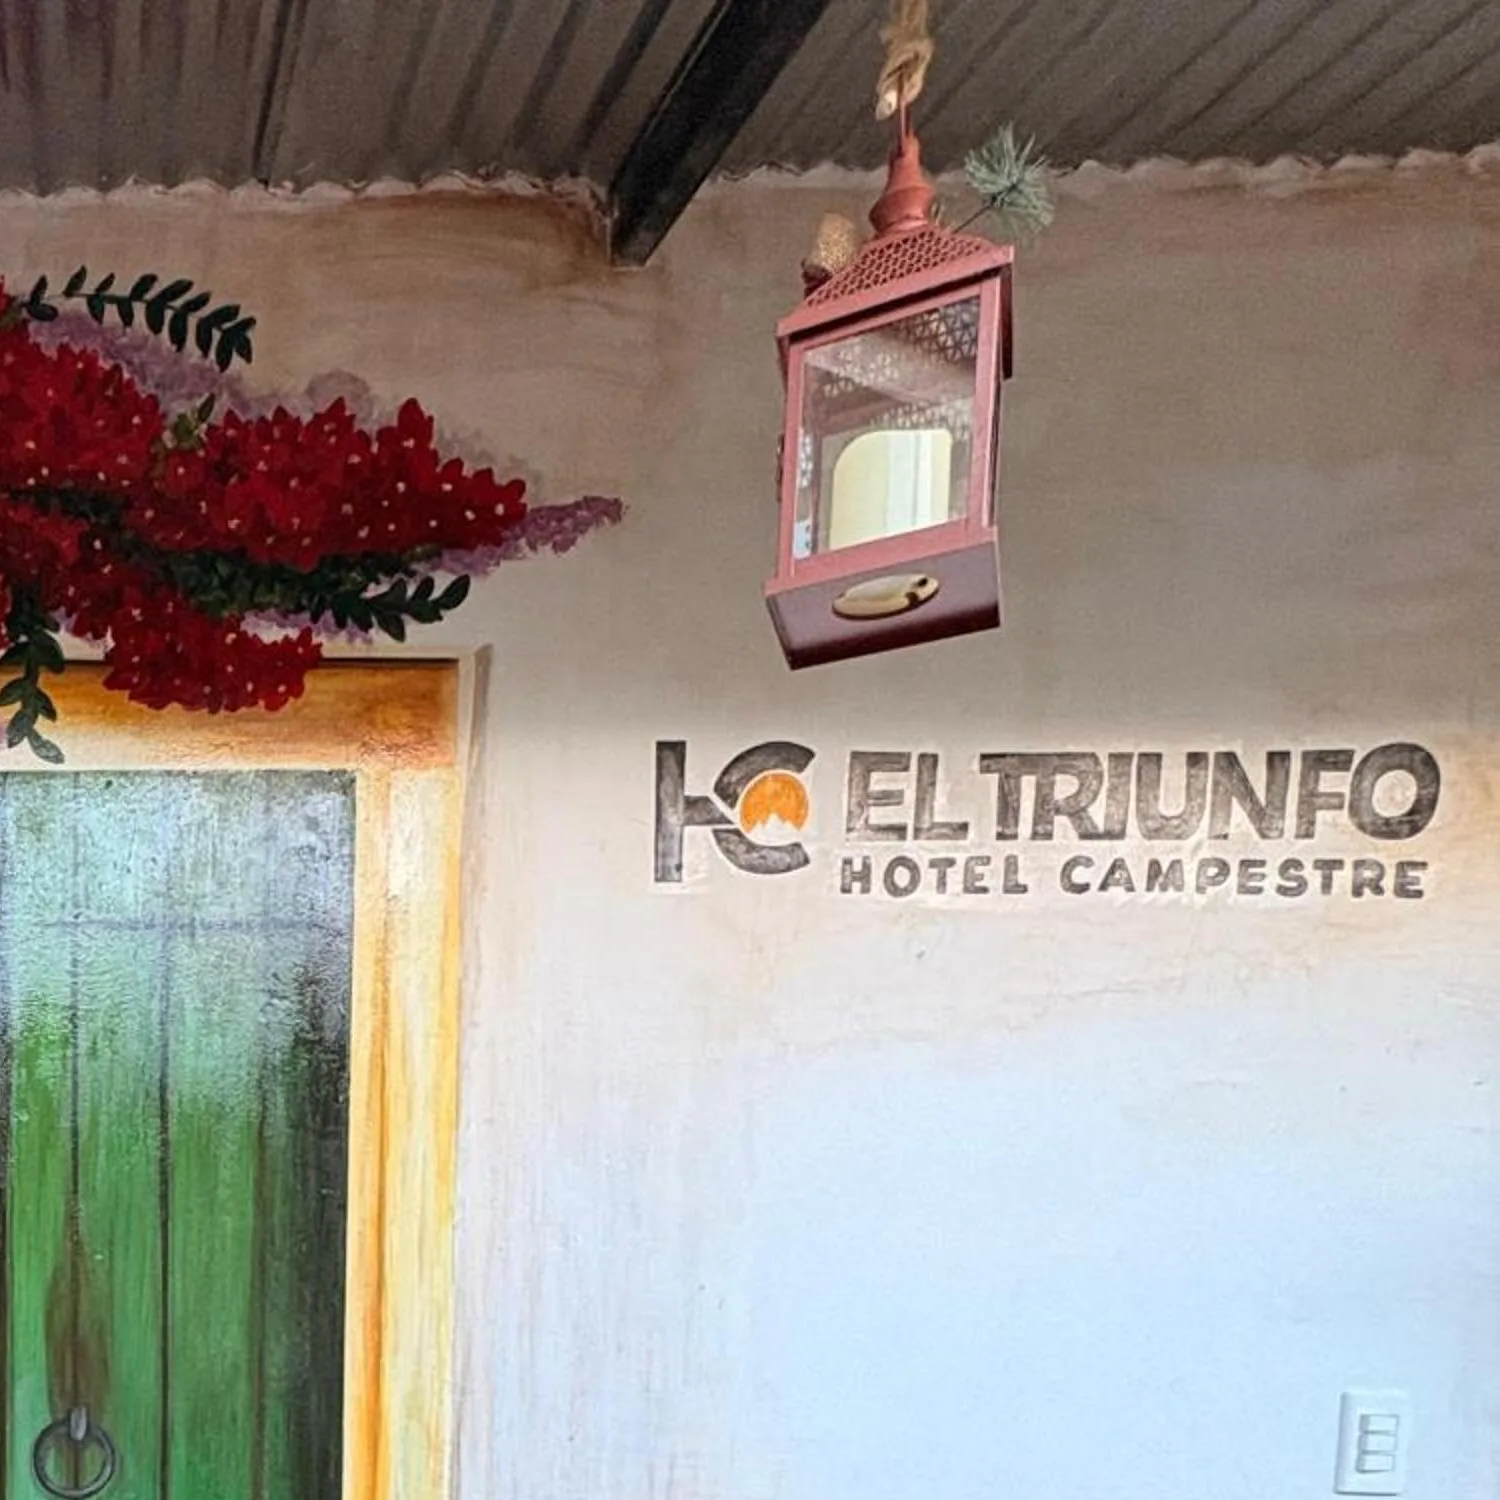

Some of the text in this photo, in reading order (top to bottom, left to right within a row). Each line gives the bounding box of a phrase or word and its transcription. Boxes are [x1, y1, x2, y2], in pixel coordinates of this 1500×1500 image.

[846, 742, 1442, 841] EL TRIUNFO
[840, 855, 1429, 899] HOTEL CAMPESTRE
